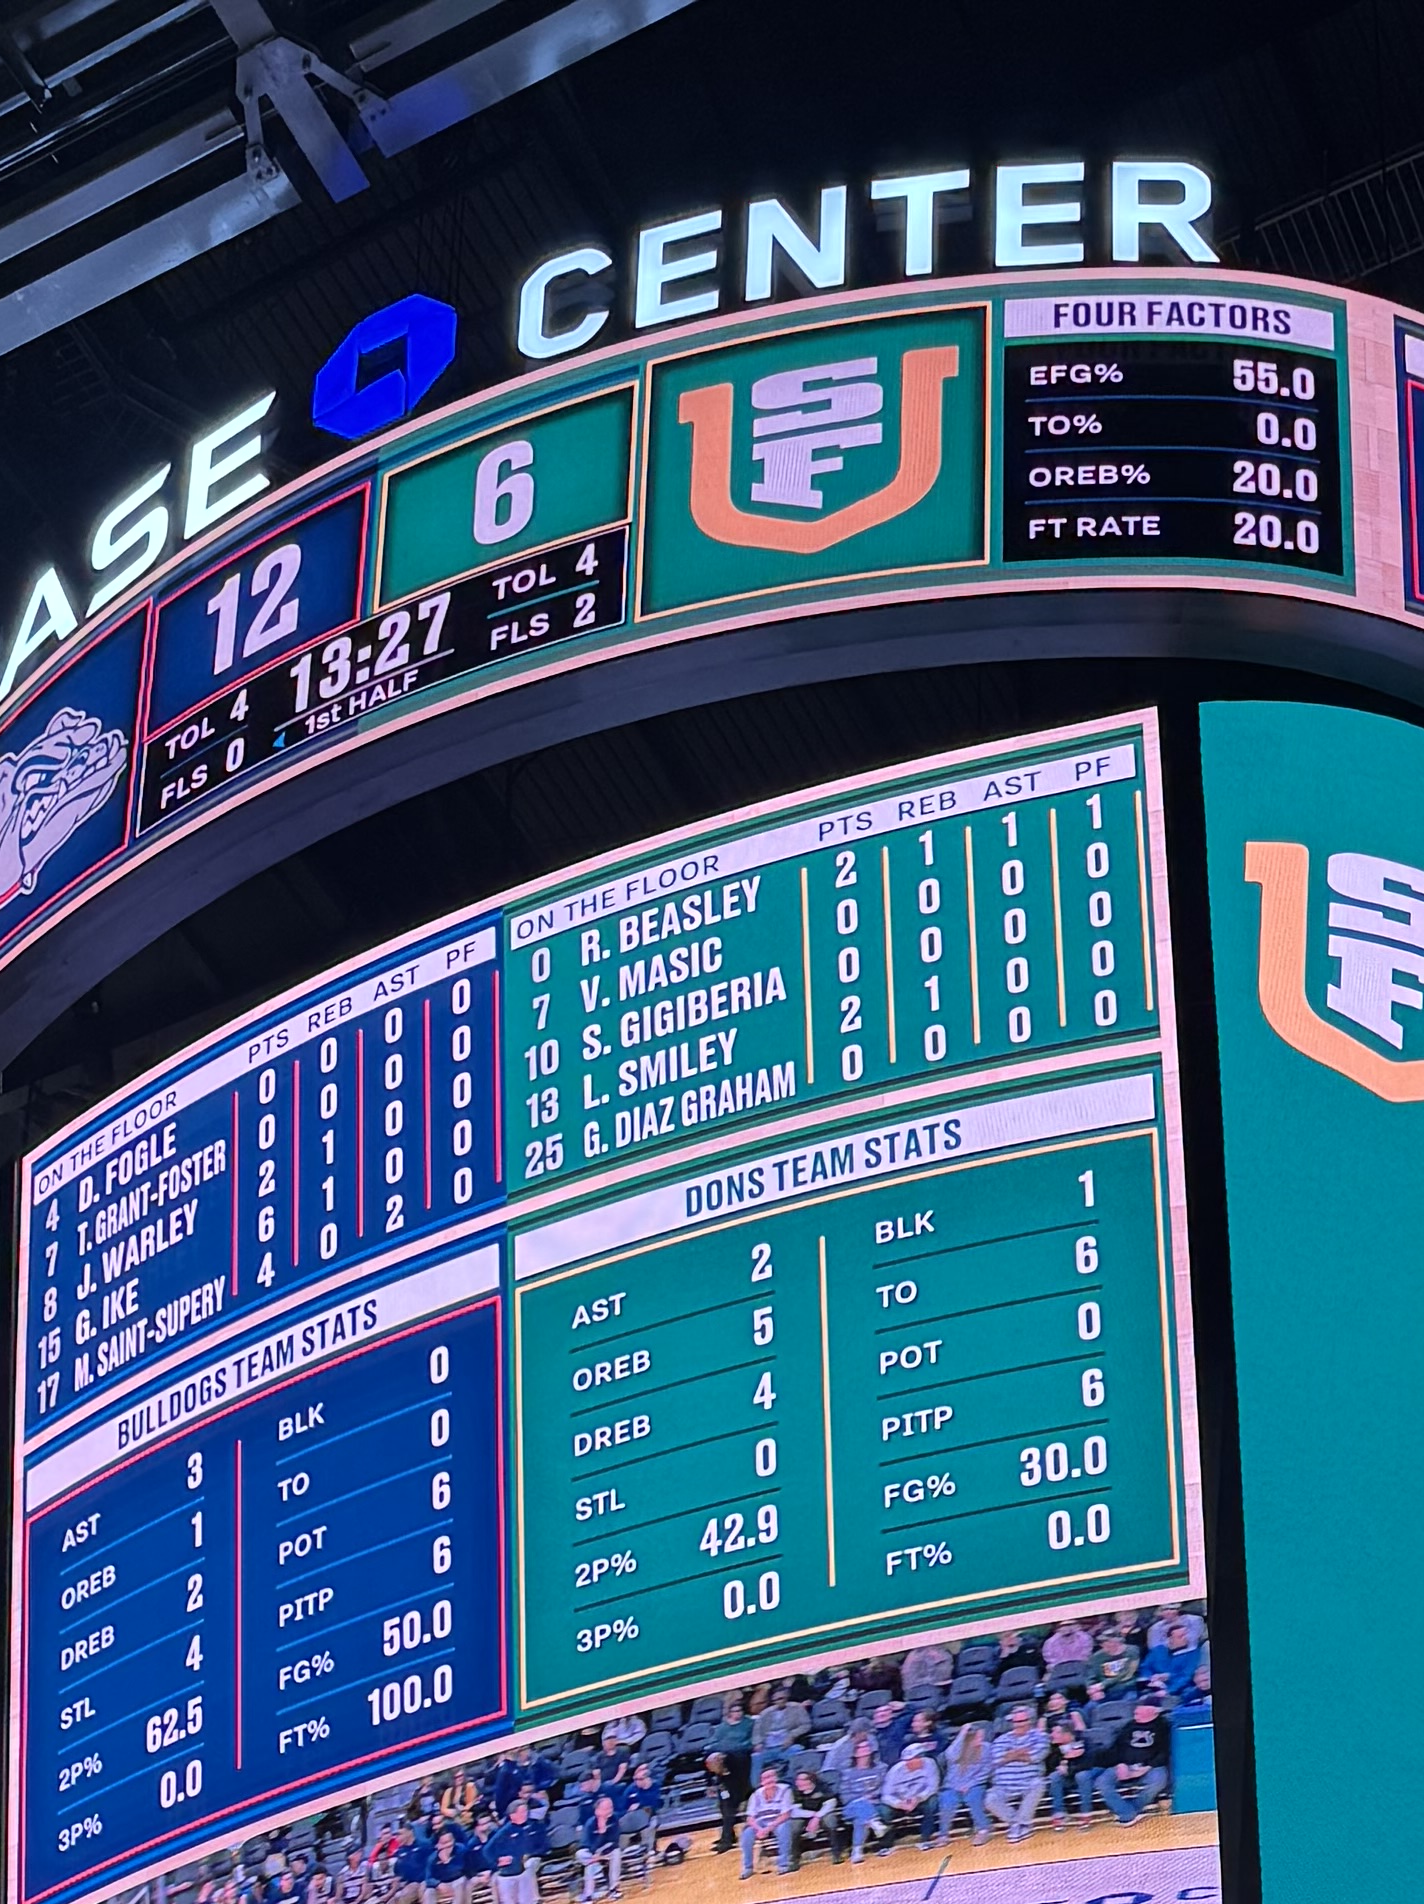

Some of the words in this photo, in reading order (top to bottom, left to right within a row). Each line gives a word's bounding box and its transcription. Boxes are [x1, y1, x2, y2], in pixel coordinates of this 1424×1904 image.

[515, 160, 1221, 360] CENTER
[1053, 301, 1138, 329] FOUR
[1145, 301, 1292, 336] FACTORS
[1029, 363, 1124, 387] EFG%
[1232, 359, 1315, 400] 55.0
[1028, 414, 1103, 437] TO%
[1256, 412, 1317, 452] 0.0
[471, 439, 535, 545] 6
[1029, 464, 1150, 488] OREB%
[1232, 461, 1318, 502] 20.0
[492, 566, 556, 600] TOL
[574, 545, 598, 575] 4
[1029, 516, 1067, 540] FT
[1076, 516, 1160, 538] RATE
[1233, 511, 1319, 554] 20.0
[207, 543, 302, 675] 12
[290, 593, 452, 714] 13:27
[490, 615, 549, 651] FLS
[573, 593, 596, 627] 2
[165, 717, 215, 758] TOL
[229, 689, 249, 723] 4
[304, 700, 341, 734] 1st
[344, 672, 420, 715] HALF
[160, 765, 208, 809] FLS
[225, 738, 244, 773] 0
[517, 910, 554, 941] ON
[564, 889, 616, 924] THE
[627, 855, 720, 904] FLOOR
[818, 812, 873, 842] PTS
[898, 791, 957, 821] REB
[983, 772, 1041, 800] AST
[1075, 757, 1112, 781] PF
[530, 948, 551, 982] 0
[580, 928, 611, 967] R.
[619, 876, 762, 951] BEASLEY
[524, 1038, 560, 1080] 10
[582, 1024, 612, 1060] S.
[619, 966, 786, 1051] GIGIBERIA
[532, 994, 550, 1030] 7
[580, 974, 610, 1012] V.
[619, 938, 722, 998] MASIC
[38, 1165, 63, 1194] ON
[70, 1145, 105, 1178] THE
[111, 1092, 178, 1153] FLOOR
[248, 1030, 289, 1063] PTS
[307, 997, 352, 1032] REB
[373, 965, 419, 1001] AST
[446, 941, 476, 968] PF
[525, 1086, 559, 1129] 13
[583, 1073, 610, 1111] L.
[618, 1028, 738, 1098] SMILEY
[524, 1134, 564, 1178] 25
[583, 1120, 609, 1159] G.
[615, 1098, 677, 1148] DIAZ
[681, 1060, 796, 1129] GRAHAM
[45, 1199, 59, 1231] 4
[78, 1177, 100, 1213] D.
[105, 1122, 177, 1192] FOGLE
[45, 1241, 58, 1277] 7
[78, 1222, 90, 1256] T.
[95, 1139, 226, 1245] GRANT-FOSTER
[685, 1166, 766, 1218] DONS
[773, 1143, 855, 1195] TEAM
[863, 1119, 963, 1170] STATS
[43, 1286, 57, 1322] 8
[78, 1264, 97, 1298] J.
[102, 1199, 197, 1287] WARLEY
[571, 1293, 627, 1328] AST
[750, 1242, 773, 1283] 2
[37, 1371, 60, 1414] 17
[74, 1350, 92, 1391] M.
[96, 1276, 226, 1376] SAINT-SUPERY
[38, 1329, 61, 1370] 15
[77, 1306, 97, 1344] G.
[103, 1278, 138, 1326] IKE
[572, 1350, 651, 1391] OREB
[753, 1307, 774, 1346] 5
[117, 1368, 227, 1450] BULLDOGS
[233, 1334, 294, 1387] TEAM
[301, 1300, 378, 1356] STATS
[574, 1414, 652, 1457] DREB
[752, 1371, 776, 1411] 4
[575, 1491, 626, 1521] STL
[755, 1438, 777, 1477] 0
[575, 1552, 637, 1588] 2P%
[699, 1504, 779, 1558] 42.9
[575, 1618, 640, 1653] 3P%
[722, 1571, 781, 1620] 0.0
